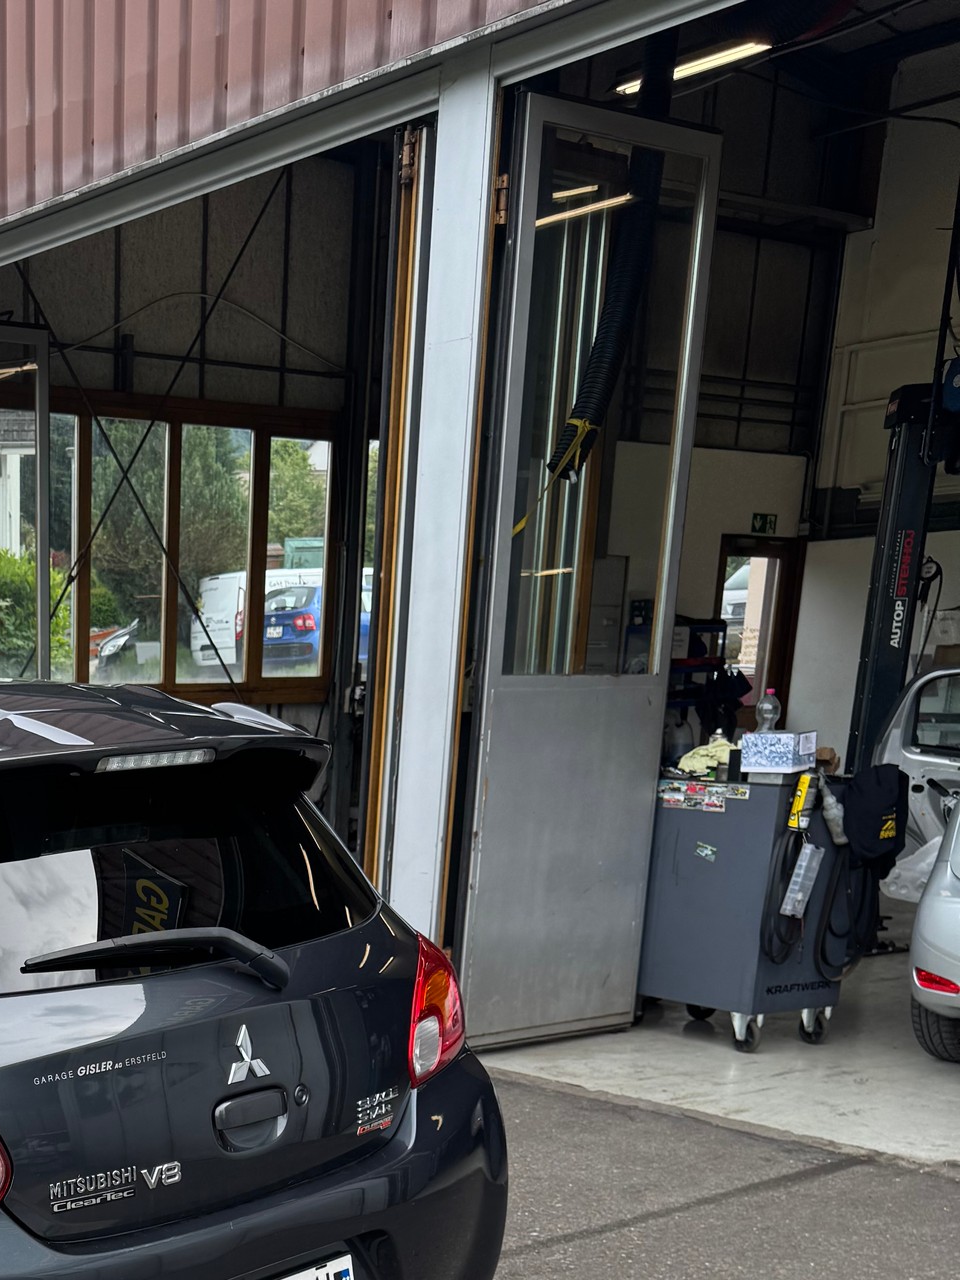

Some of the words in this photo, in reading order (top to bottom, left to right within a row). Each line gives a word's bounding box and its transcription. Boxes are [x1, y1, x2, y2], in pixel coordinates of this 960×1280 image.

[890, 600, 903, 649] AUTOP
[765, 980, 832, 996] KRAFTWERK
[33, 1070, 74, 1086] GARAGE
[77, 1060, 113, 1077] GISLER
[114, 1062, 123, 1070] AG
[125, 1051, 167, 1067] ERSTFELD
[49, 1165, 137, 1200] MITSUBISHI
[140, 1160, 182, 1190] V8
[52, 1189, 135, 1213] ClearTec
